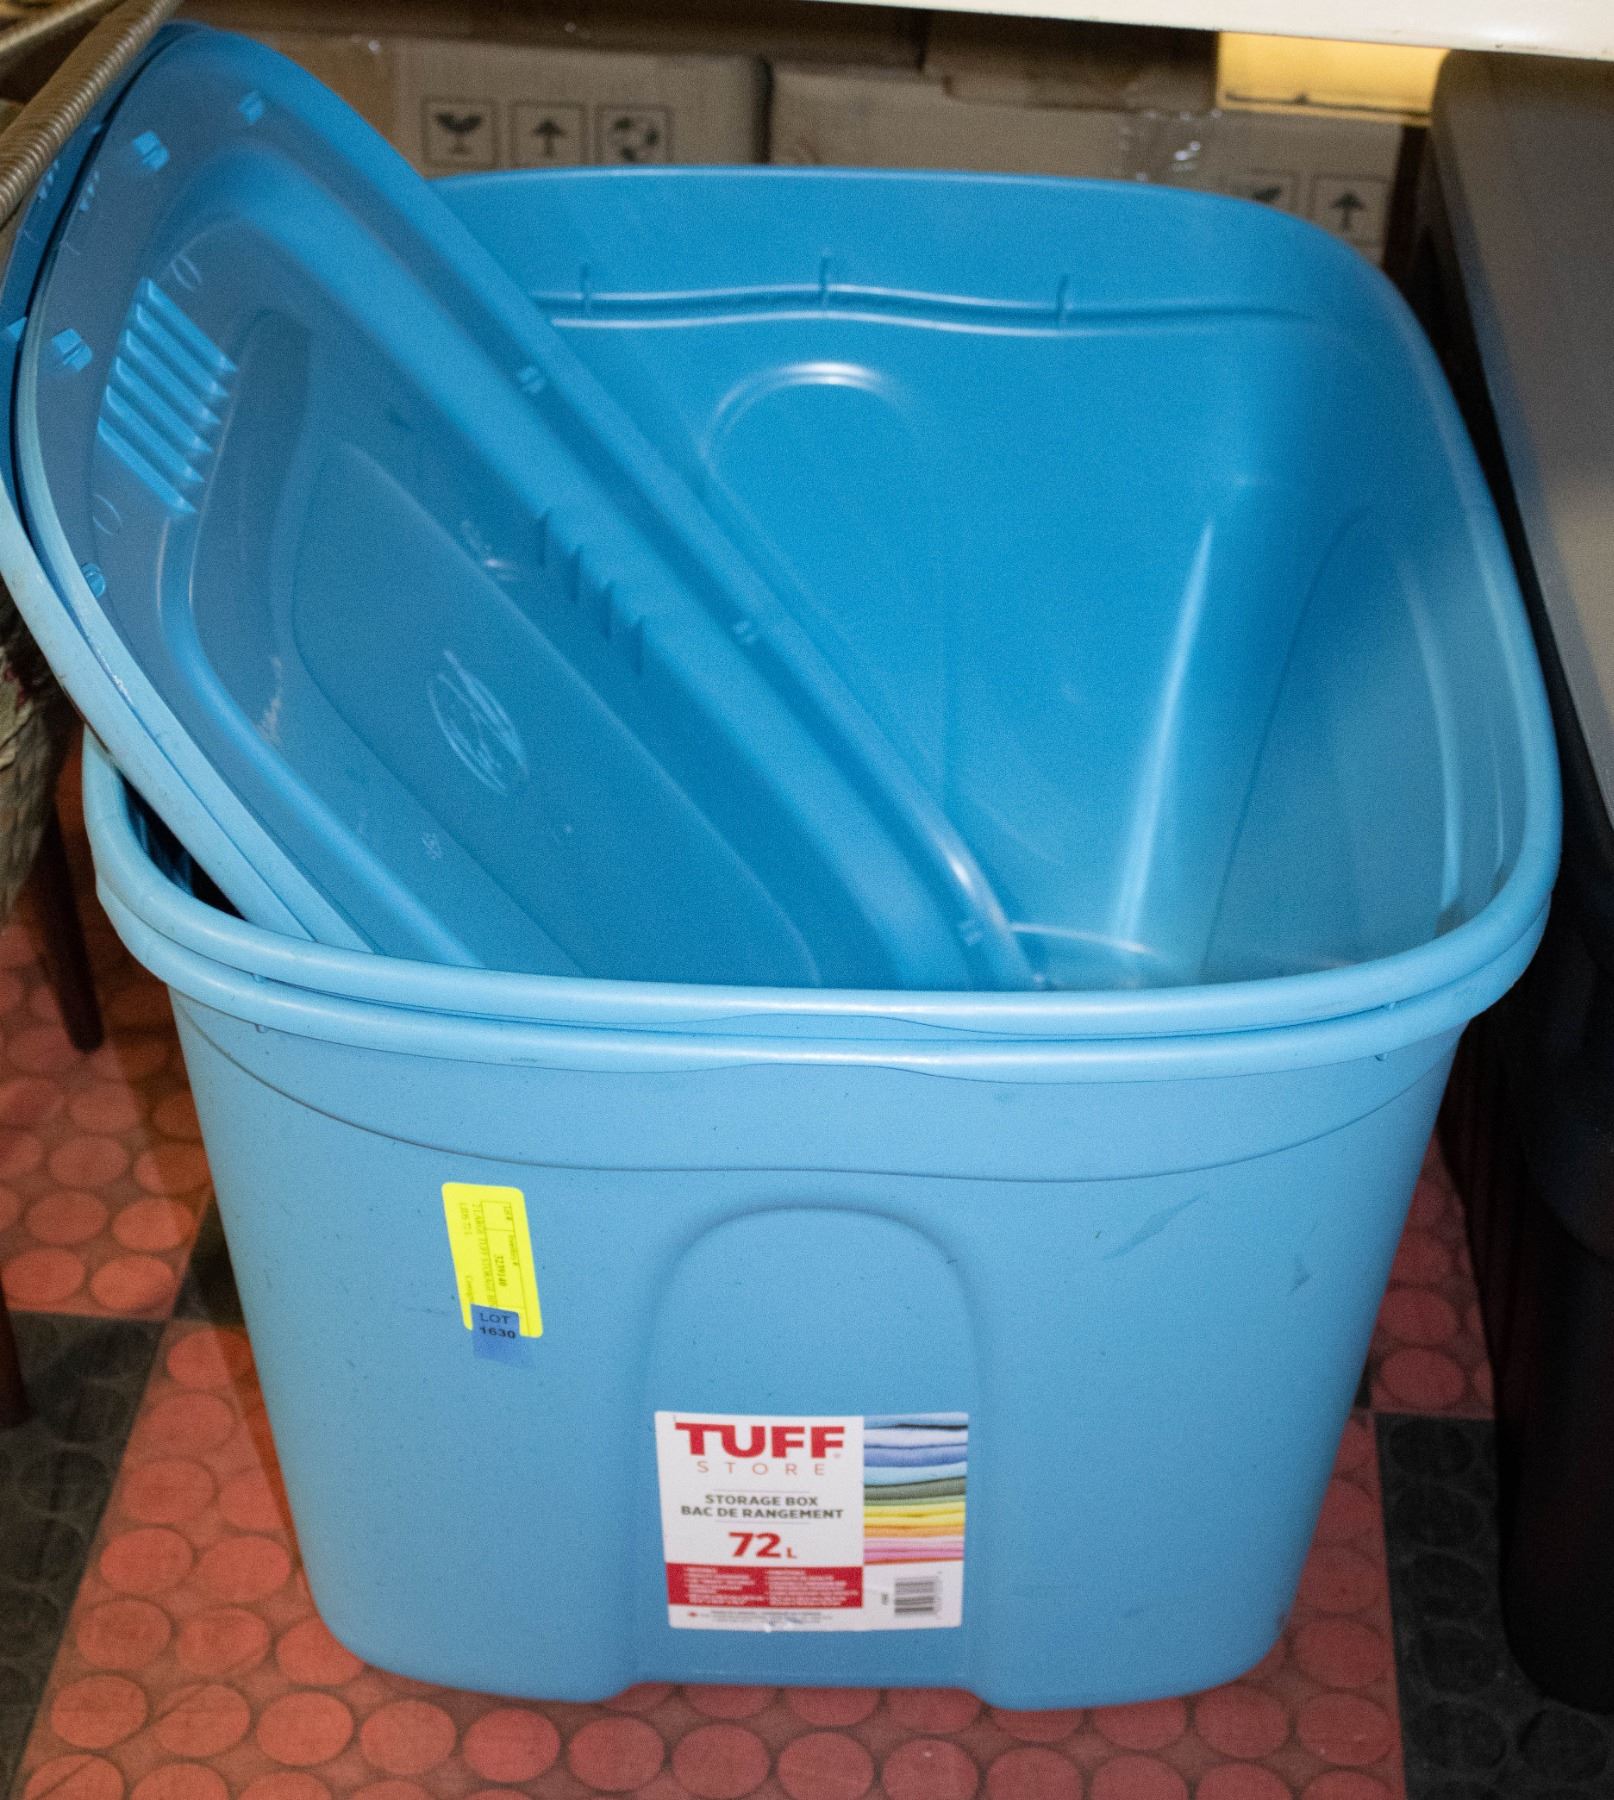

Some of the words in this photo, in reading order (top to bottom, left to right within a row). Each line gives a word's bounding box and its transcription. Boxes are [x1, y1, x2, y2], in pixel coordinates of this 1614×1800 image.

[480, 1312, 510, 1324] LOT
[480, 1327, 516, 1339] 1630
[675, 1422, 845, 1458] TUFF
[697, 1461, 826, 1476] STORE
[705, 1494, 780, 1506] STORAGE
[785, 1496, 818, 1506] BOX
[681, 1506, 712, 1517] BAC
[718, 1507, 737, 1518] DE
[742, 1508, 843, 1519] RANGEMENT
[729, 1532, 781, 1558] 72
[787, 1548, 797, 1558] L
